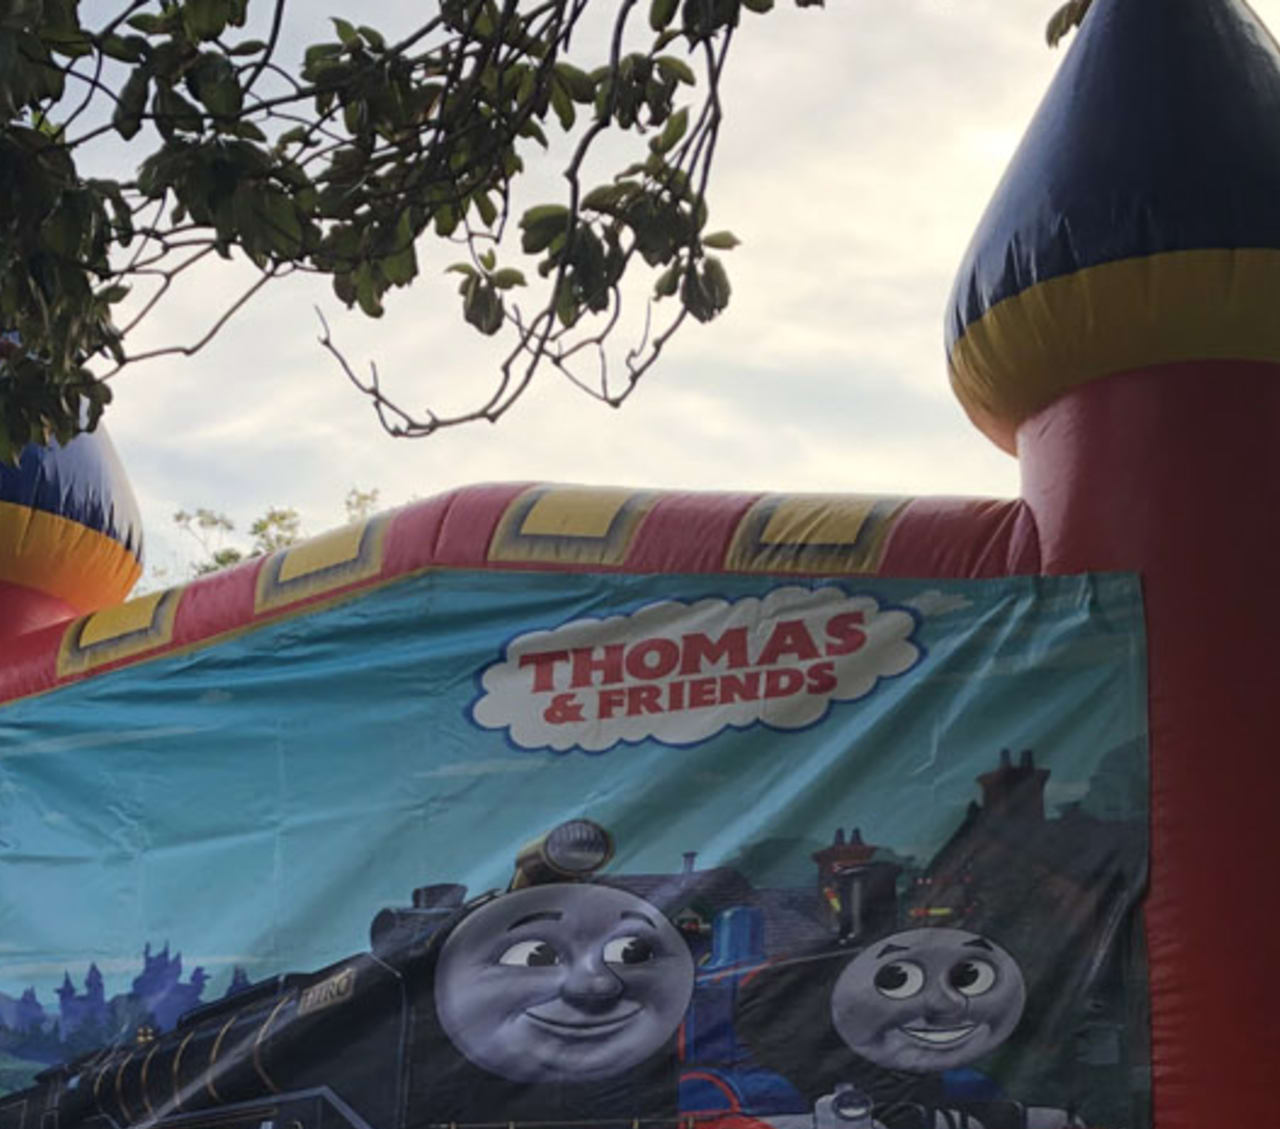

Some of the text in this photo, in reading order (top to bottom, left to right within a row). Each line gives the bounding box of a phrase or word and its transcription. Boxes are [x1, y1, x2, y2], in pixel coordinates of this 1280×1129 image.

[518, 611, 867, 693] THOMAS
[542, 663, 838, 725] & FRIENDS
